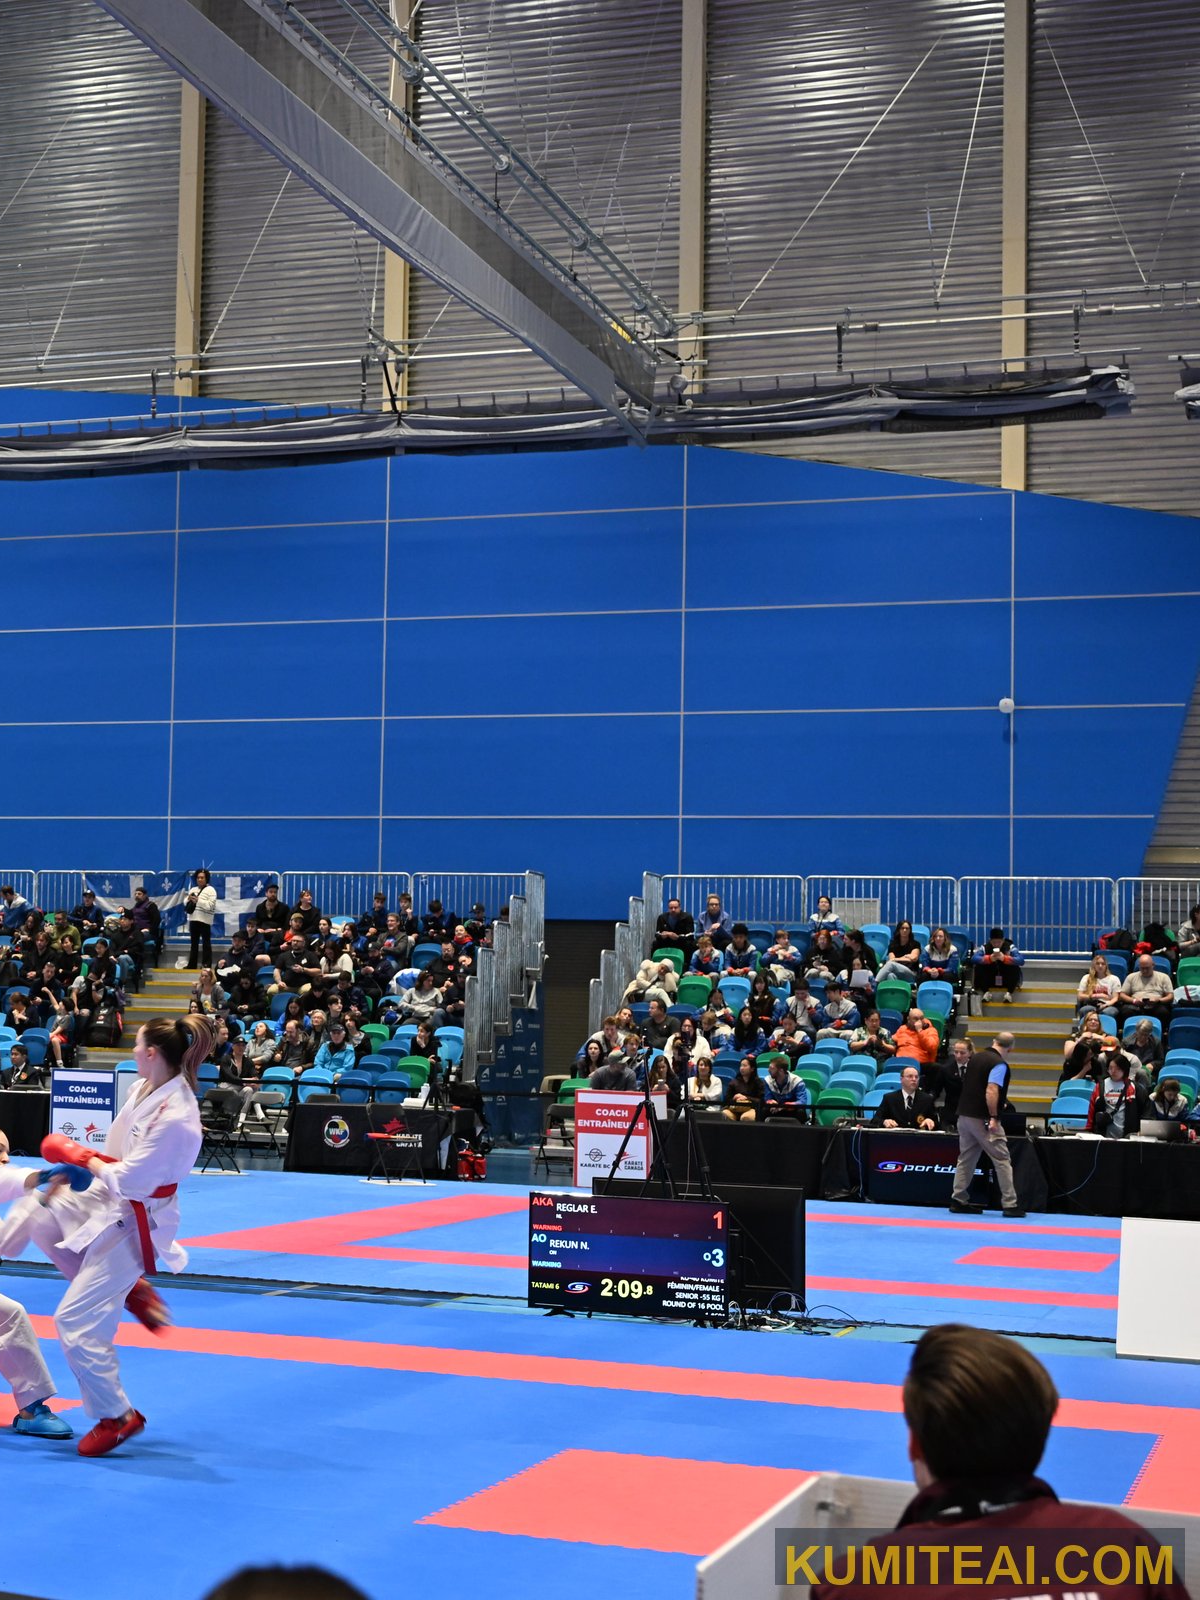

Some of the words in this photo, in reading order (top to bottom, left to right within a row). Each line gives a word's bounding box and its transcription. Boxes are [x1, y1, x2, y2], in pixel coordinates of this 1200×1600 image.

[68, 1085, 97, 1093] COACH
[595, 1108, 629, 1117] COACH
[329, 1128, 344, 1136] WKF
[532, 1197, 554, 1206] AKA
[556, 1203, 588, 1213] REGLAR
[590, 1205, 598, 1213] E.
[713, 1211, 722, 1229] 1
[531, 1233, 547, 1242] AO
[549, 1239, 578, 1249] REKUN
[580, 1241, 590, 1250] N.
[531, 1260, 562, 1268] WARNING
[531, 1281, 554, 1289] TATAMI
[667, 1281, 720, 1292] FÉMININ/FEMALE
[675, 1292, 699, 1300] SENIOR
[700, 1293, 710, 1301] -55
[662, 1300, 686, 1308] ROUND
[706, 1303, 724, 1311] POOL
